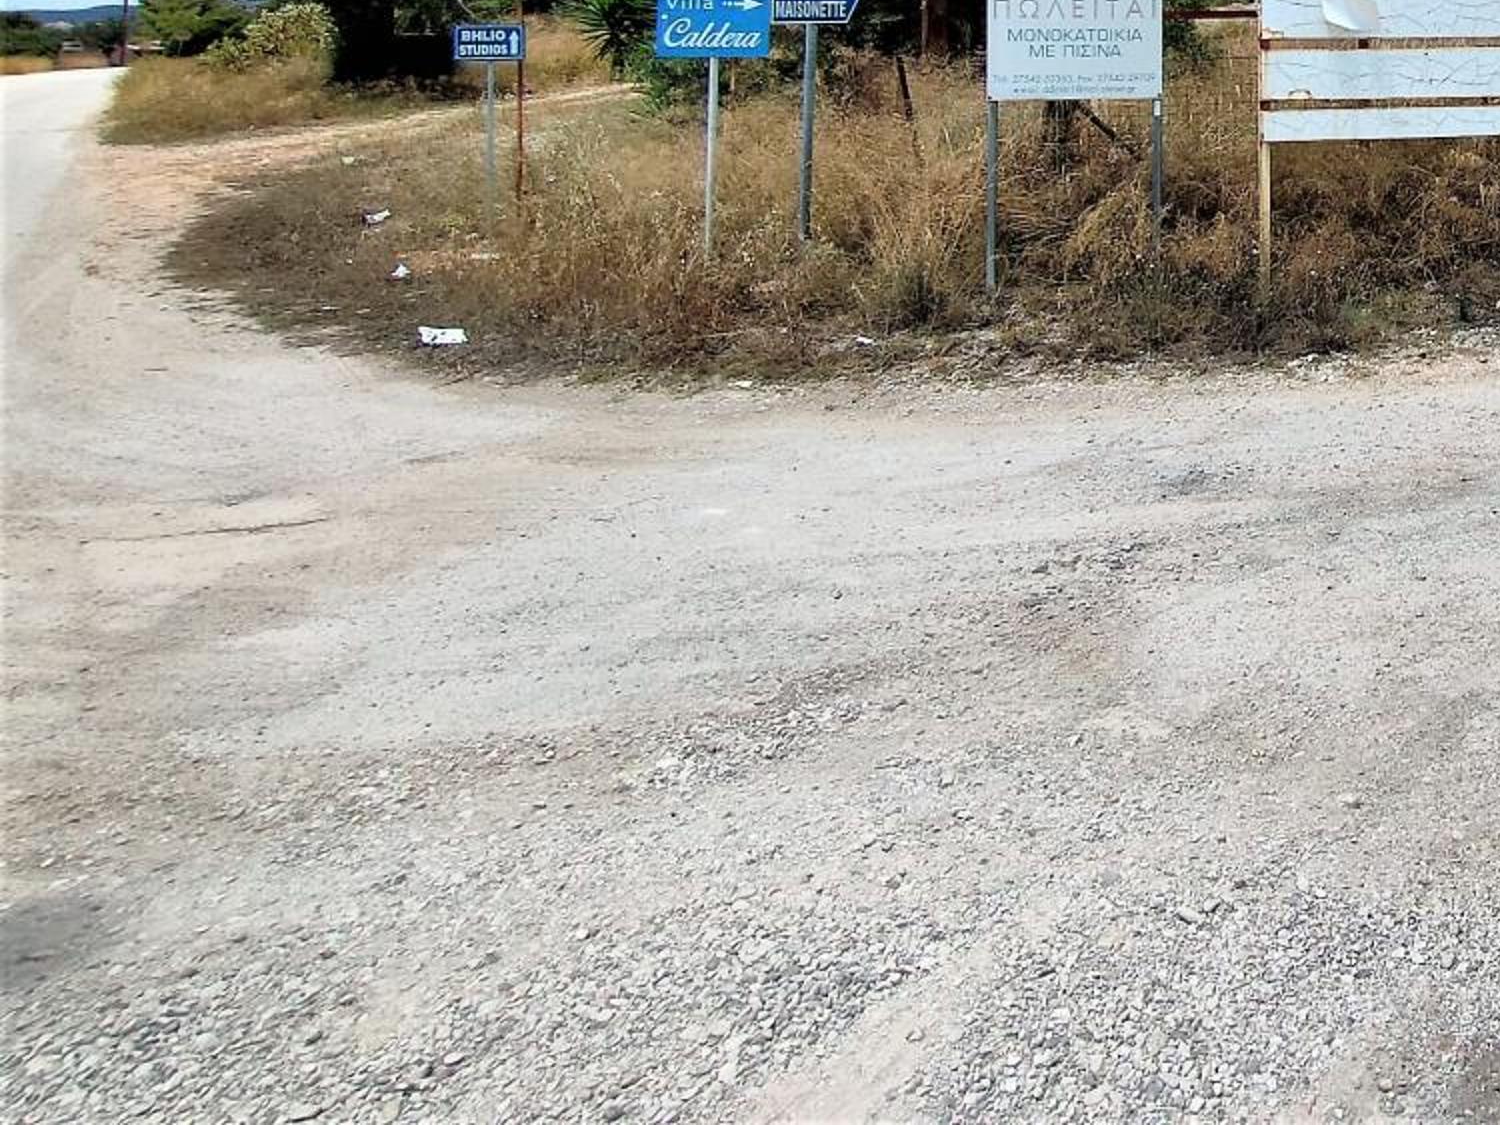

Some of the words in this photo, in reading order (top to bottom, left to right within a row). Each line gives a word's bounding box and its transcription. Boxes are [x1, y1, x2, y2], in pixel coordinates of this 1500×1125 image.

[775, 0, 847, 18] MAISONETTE
[663, 18, 761, 49] Caldera
[1007, 28, 1143, 42] ΜΟΝΟΚΑΤΟΙΚΙΑ
[460, 44, 508, 56] STUDIOS
[1029, 44, 1056, 58] ΜΕ
[1063, 45, 1121, 58] ΠΙΣΙΝΑ
